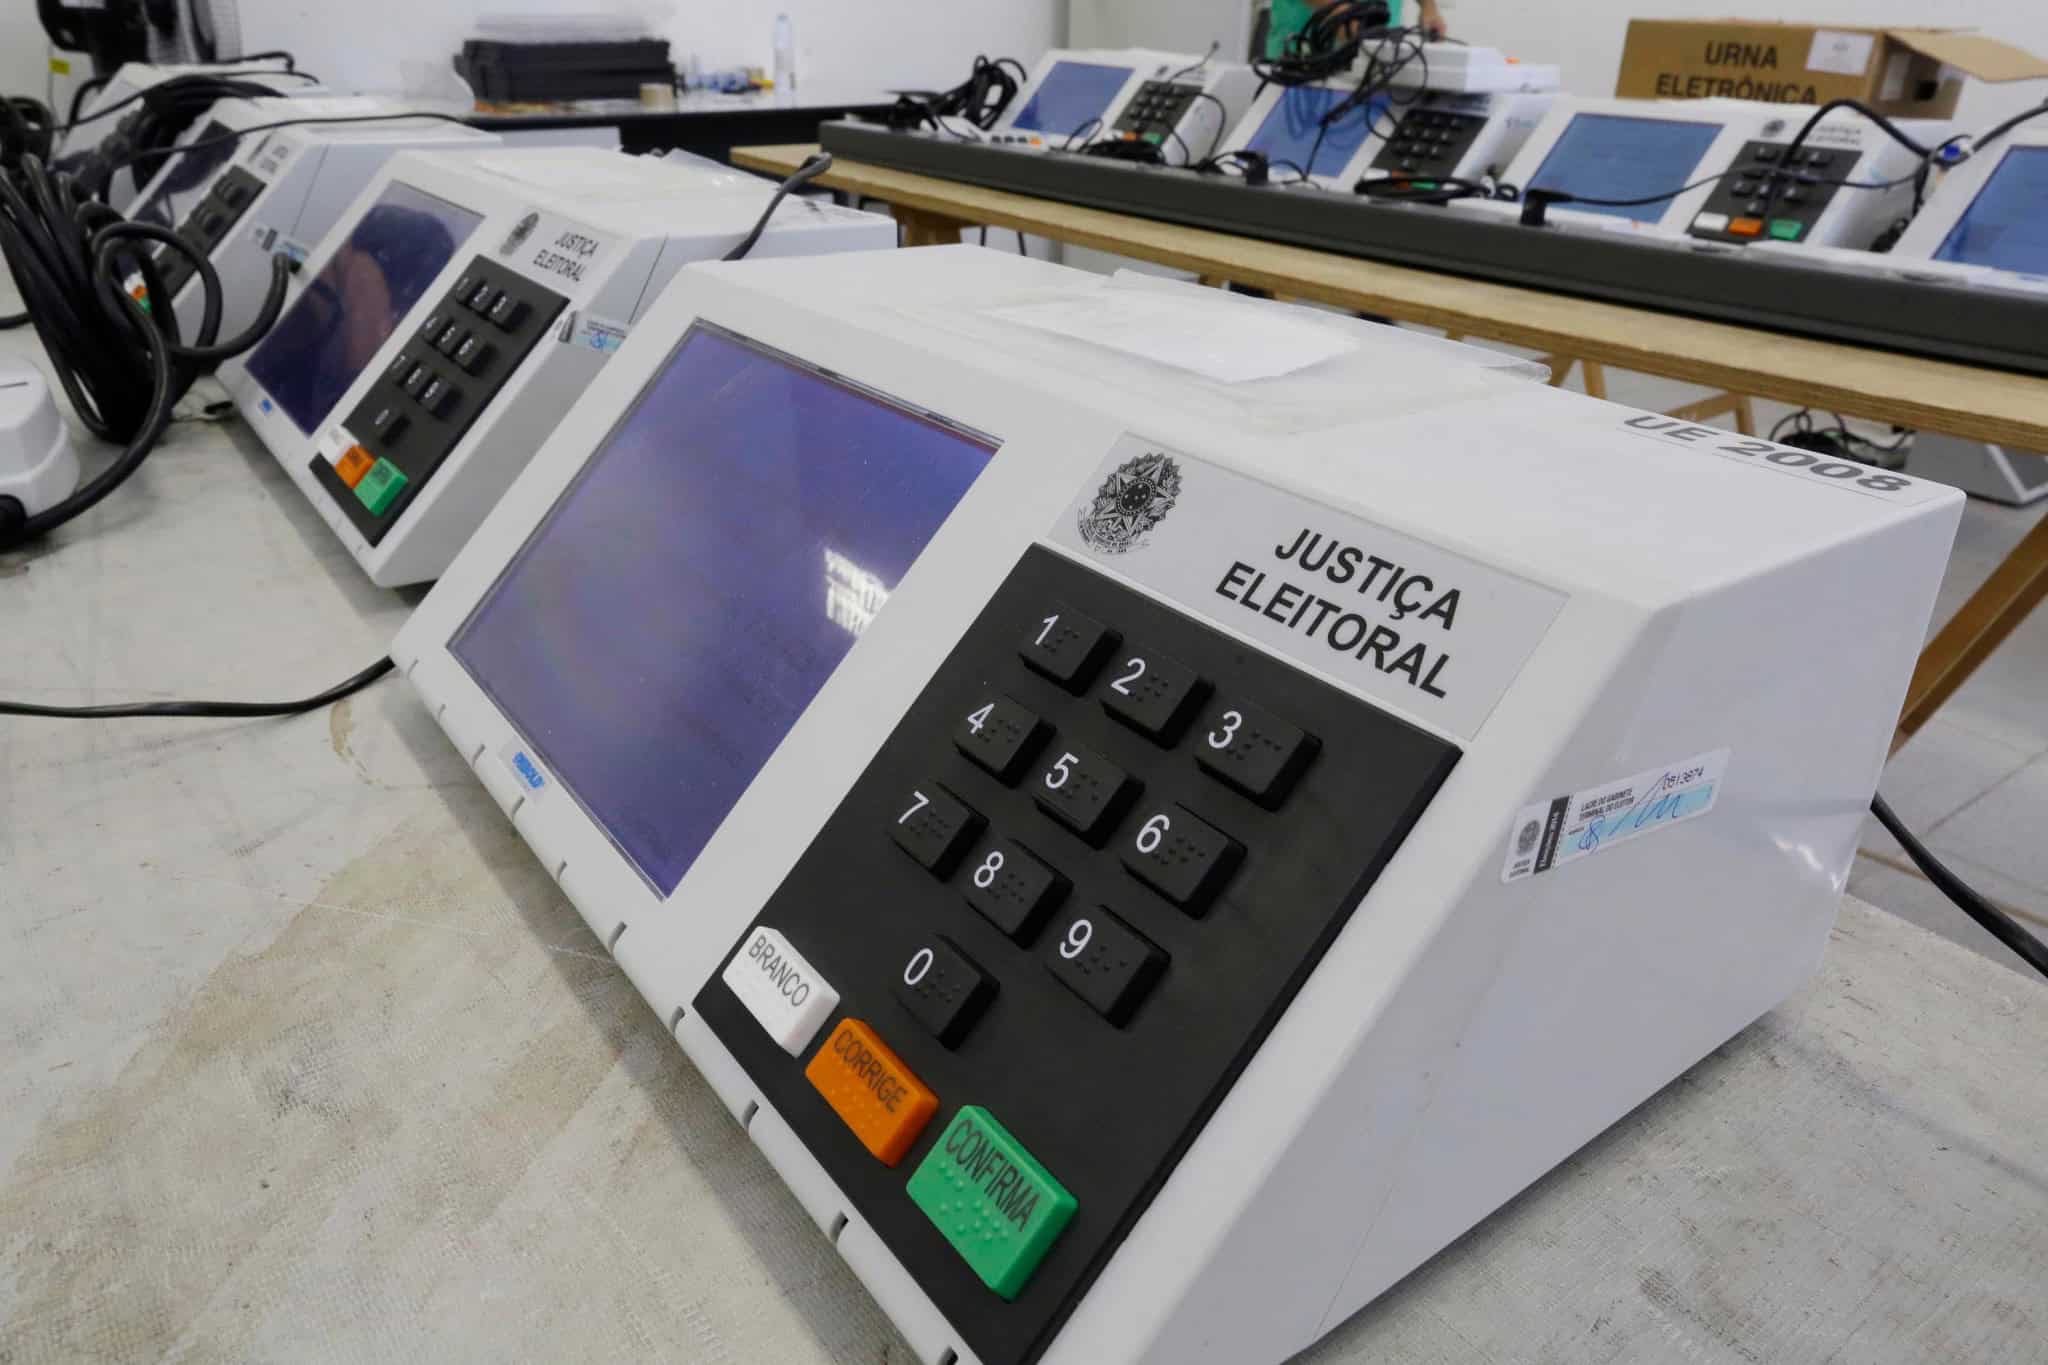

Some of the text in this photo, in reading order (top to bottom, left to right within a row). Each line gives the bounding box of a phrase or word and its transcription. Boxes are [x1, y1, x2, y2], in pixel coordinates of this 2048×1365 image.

[1704, 41, 1778, 69] URNA
[1624, 415, 1912, 492] UE 2008
[1215, 561, 1450, 699] ELEITORAL
[1274, 528, 1461, 631] JUSTIÇA
[1034, 615, 1242, 748] 1 2 3
[967, 703, 1170, 853] 4 5 6
[899, 791, 1092, 959] 7 8 9
[748, 934, 811, 1007] BRANCO
[903, 948, 934, 985] 0
[832, 1029, 909, 1113] CORRIGE
[945, 1119, 1041, 1232] CONFIRMA
